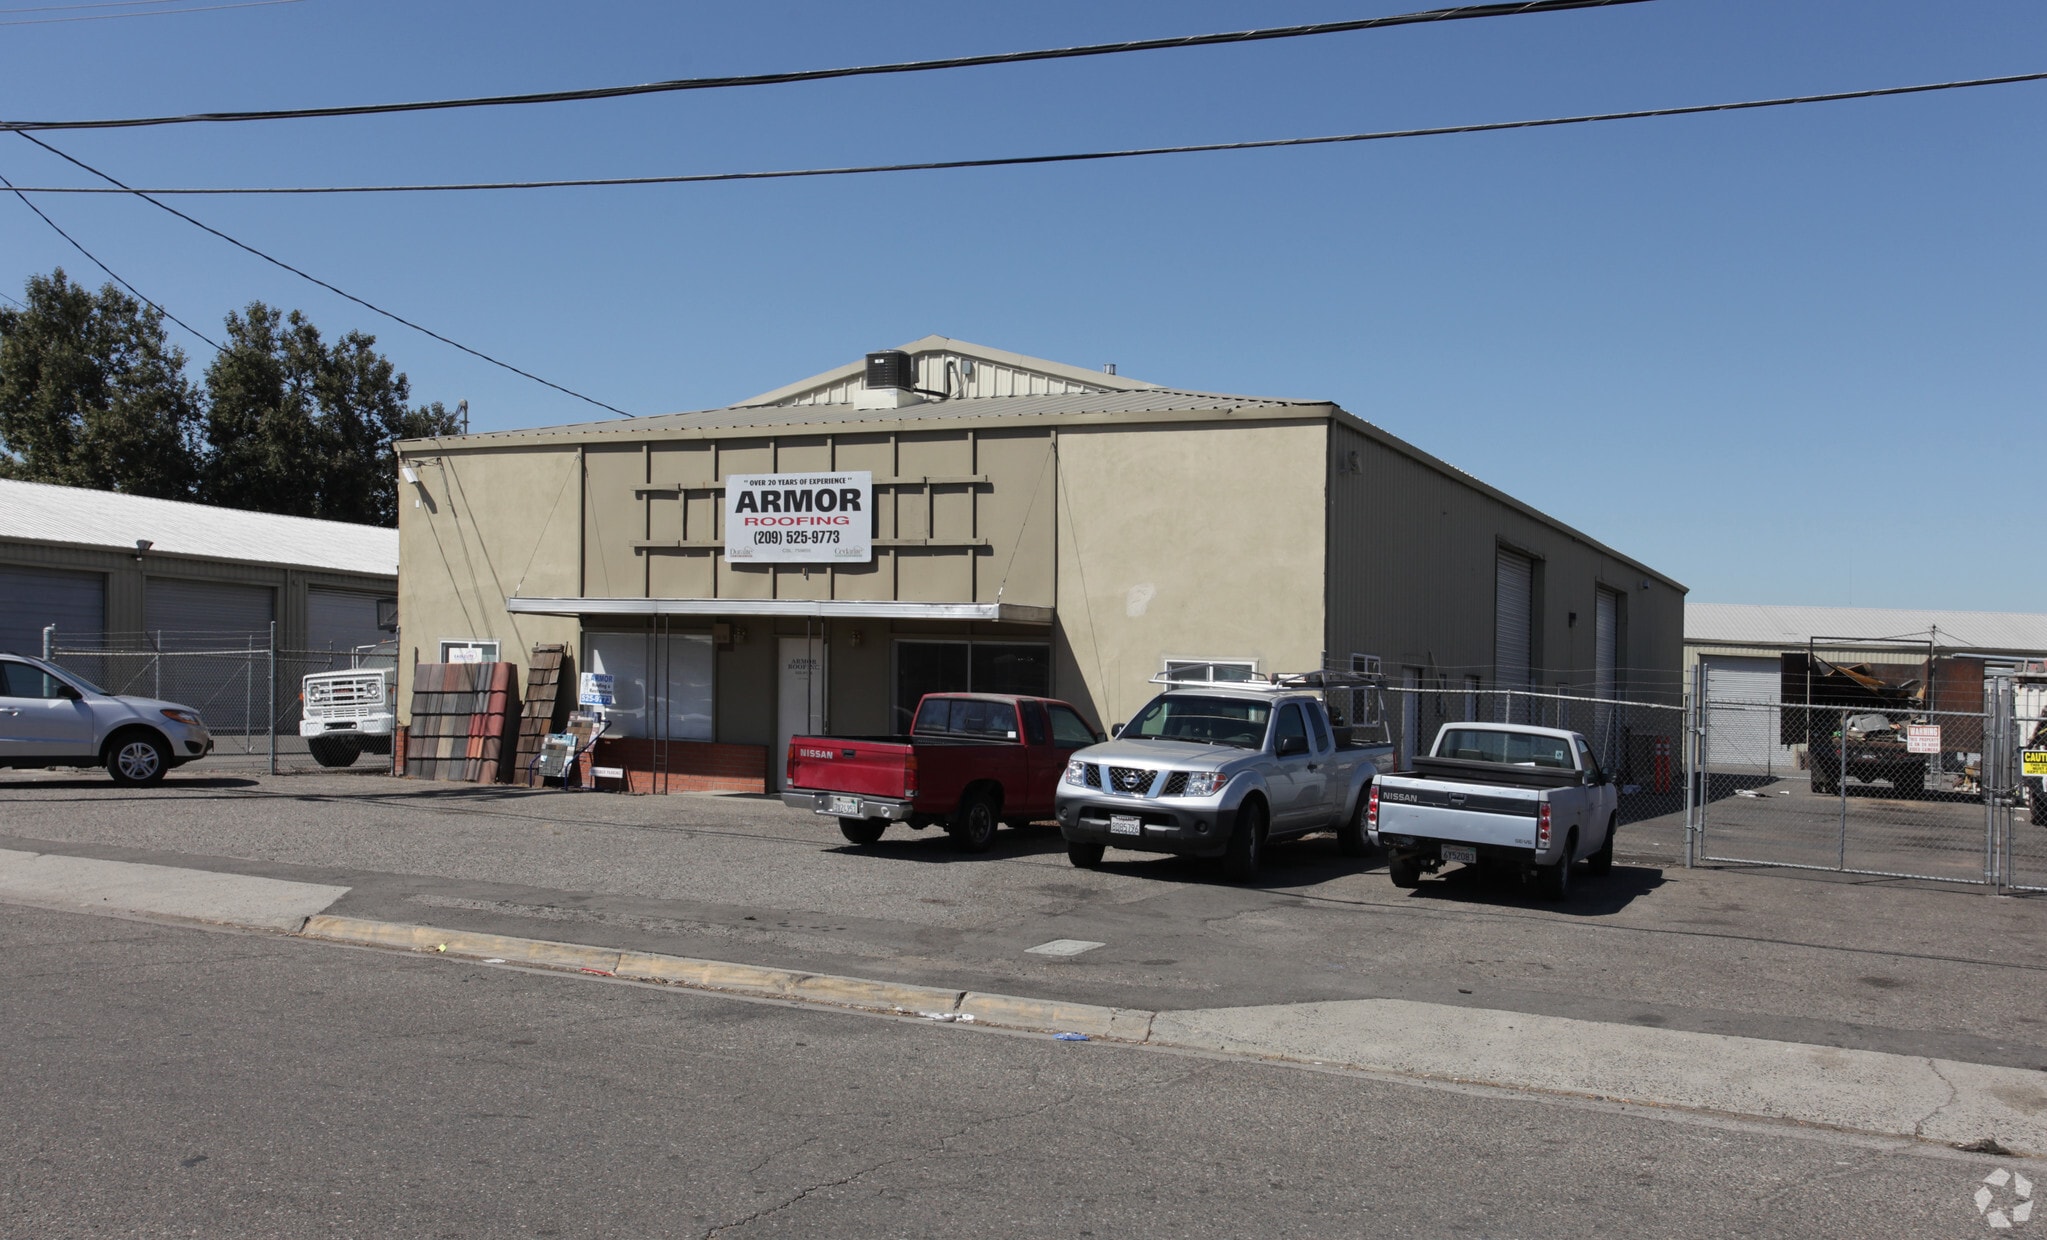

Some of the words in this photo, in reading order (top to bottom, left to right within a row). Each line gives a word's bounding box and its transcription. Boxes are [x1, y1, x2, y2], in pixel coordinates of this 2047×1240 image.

[736, 488, 861, 514] ARMOR
[744, 516, 850, 526] ROOFING
[754, 530, 782, 545] (209)
[786, 530, 840, 544] 525-9773
[582, 695, 610, 703] 525-9773
[1910, 727, 1937, 736] WARNING
[800, 749, 833, 759] NISSAN
[1383, 792, 1418, 803] NISSAN
